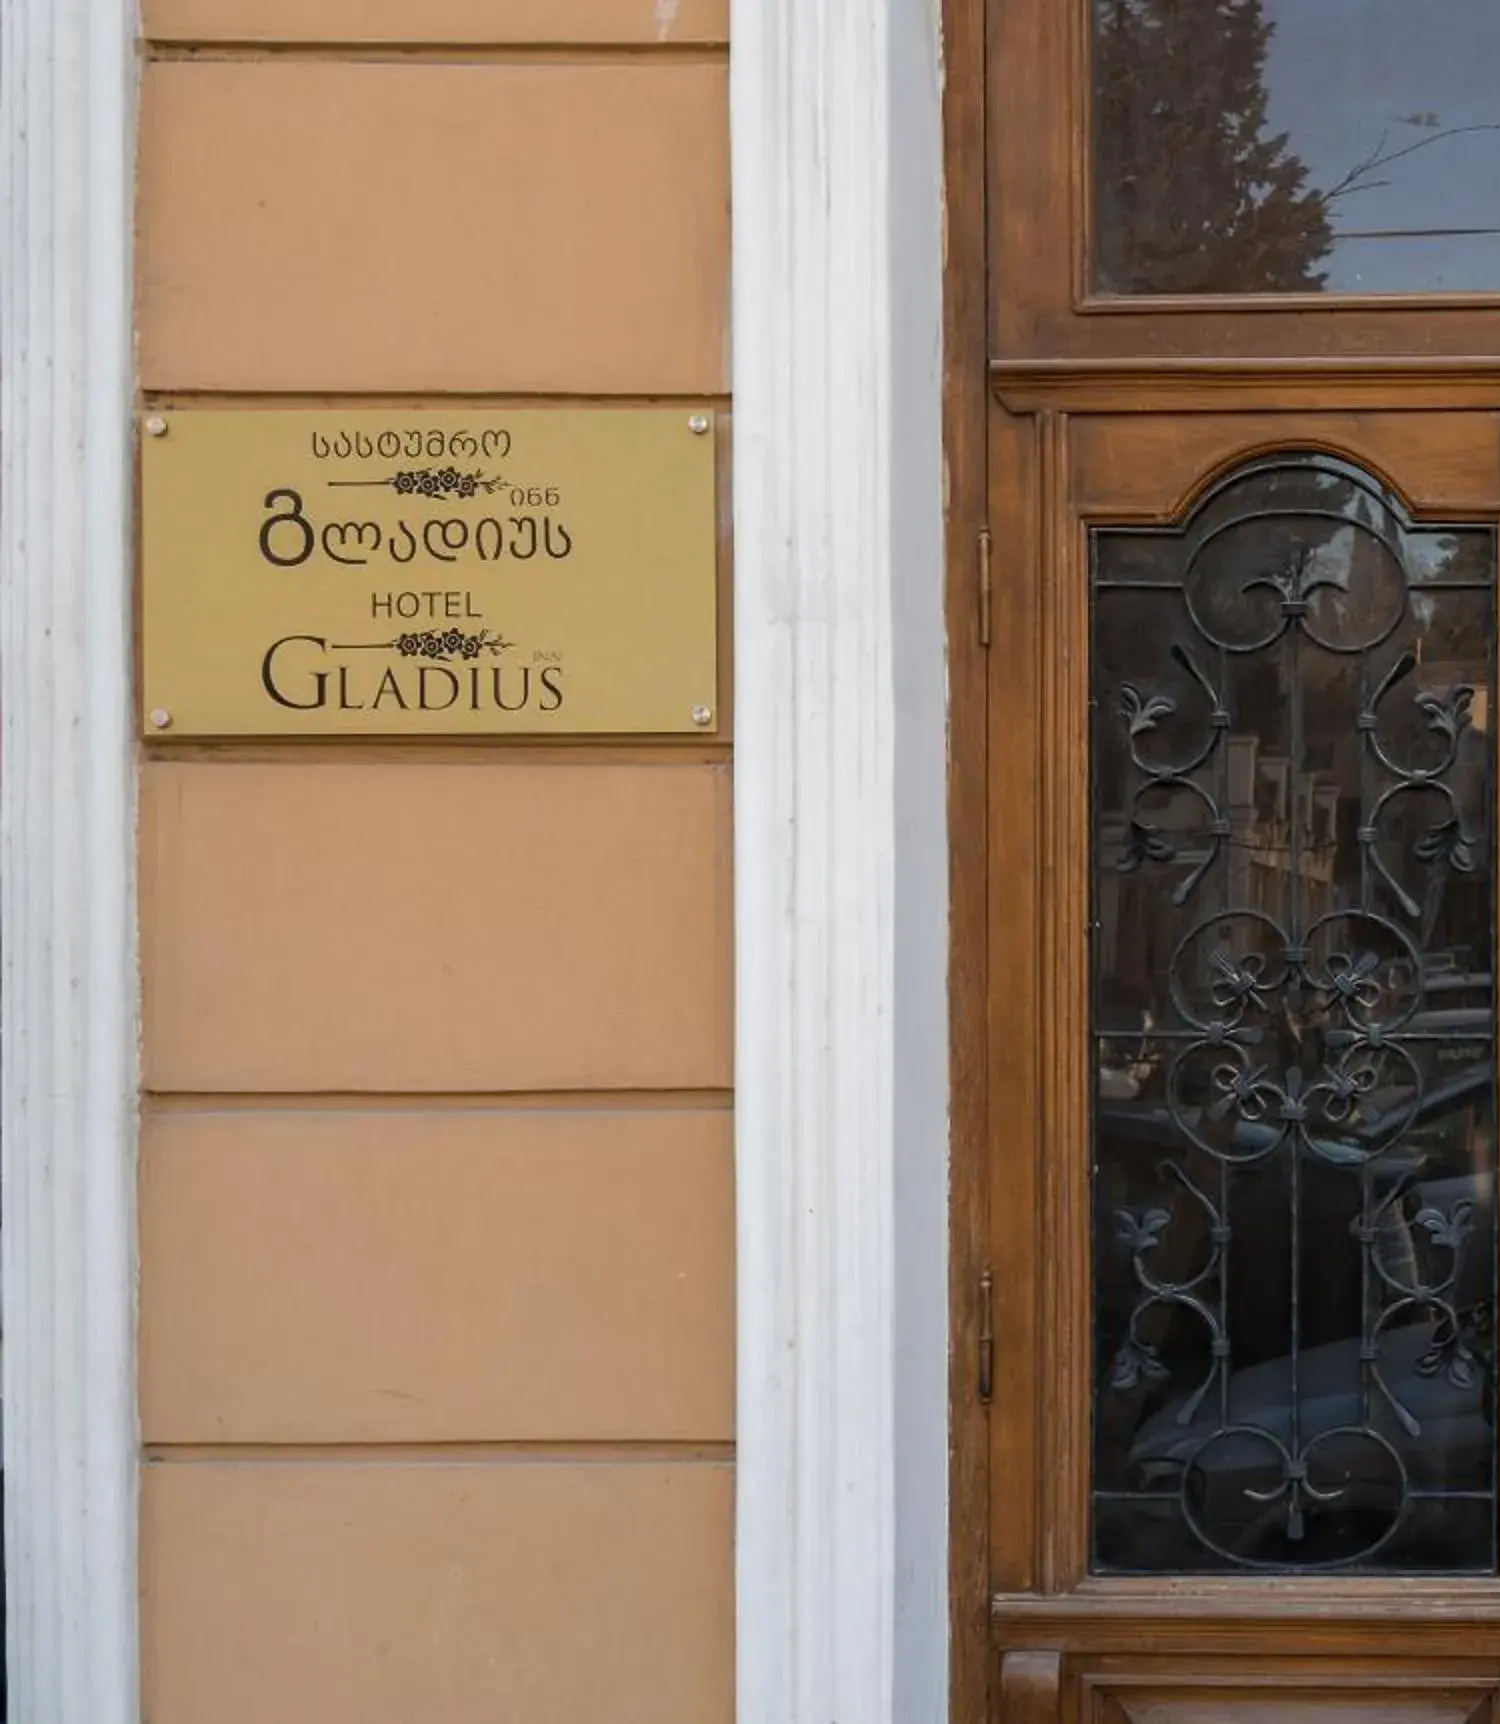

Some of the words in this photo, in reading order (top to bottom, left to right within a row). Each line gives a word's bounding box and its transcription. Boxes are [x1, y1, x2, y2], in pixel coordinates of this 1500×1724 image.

[312, 429, 511, 459] სასტუმრო
[508, 485, 560, 507] ინნ
[259, 488, 573, 567] გლადიუს
[371, 591, 483, 619] HOTEL
